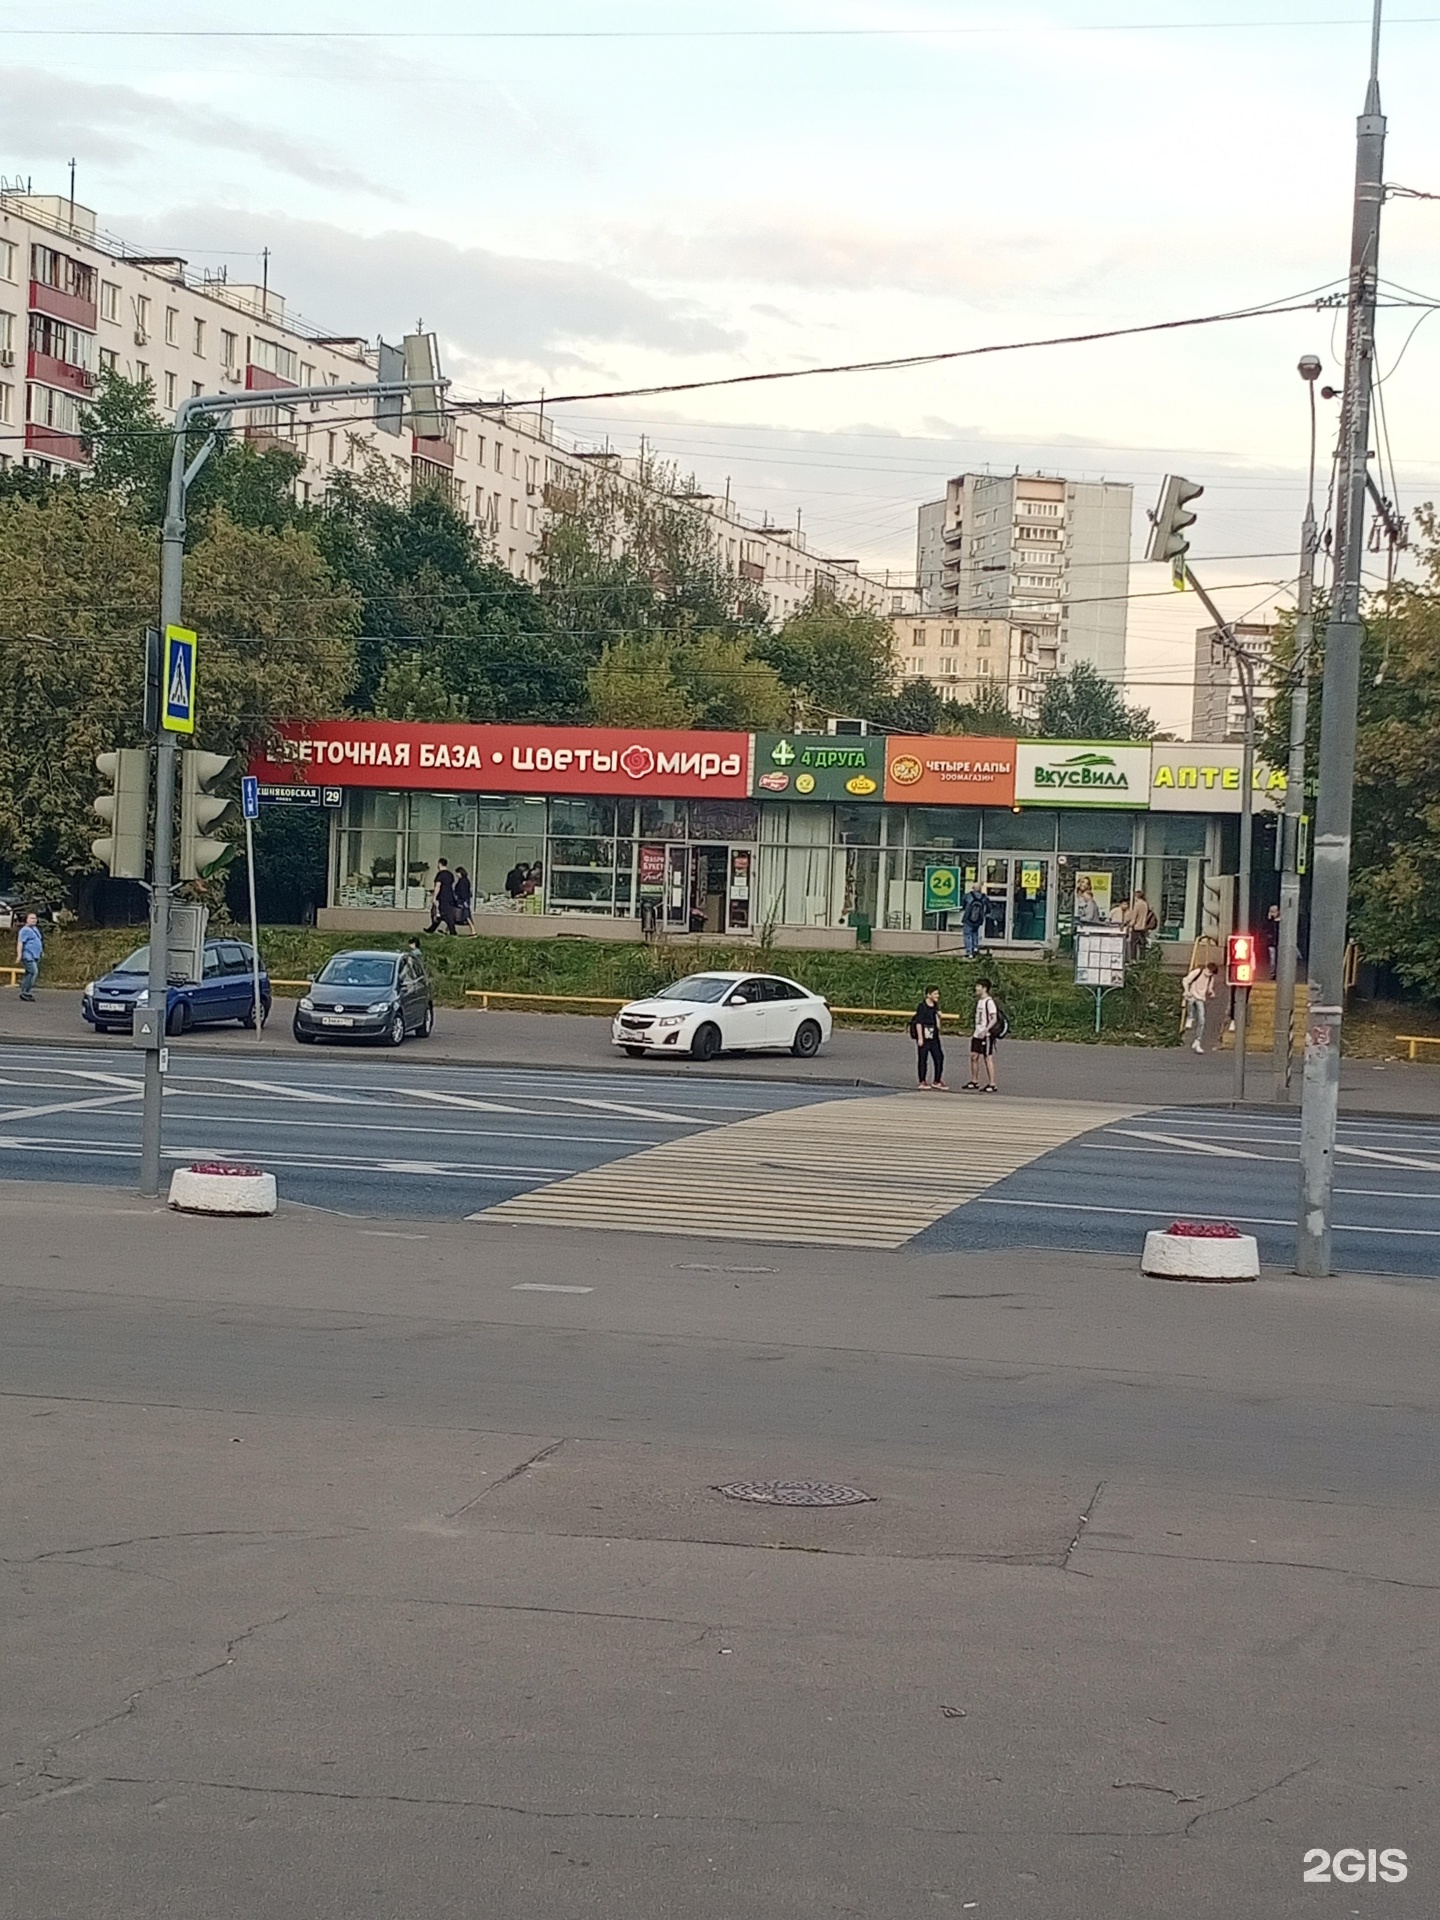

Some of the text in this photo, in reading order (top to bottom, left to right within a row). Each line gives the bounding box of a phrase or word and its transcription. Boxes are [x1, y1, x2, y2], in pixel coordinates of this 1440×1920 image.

[419, 744, 482, 769] БАЗА
[801, 751, 866, 767] 4 ДРУГА
[925, 760, 970, 772] ЧЕТЫРЕ
[973, 762, 1011, 773] ЛАПЫ
[940, 773, 994, 782] ЗООМАГАЗИН
[1153, 765, 1288, 790] АПТЕКА
[326, 791, 340, 802] 29
[933, 877, 951, 889] 24
[1024, 873, 1038, 884] 24
